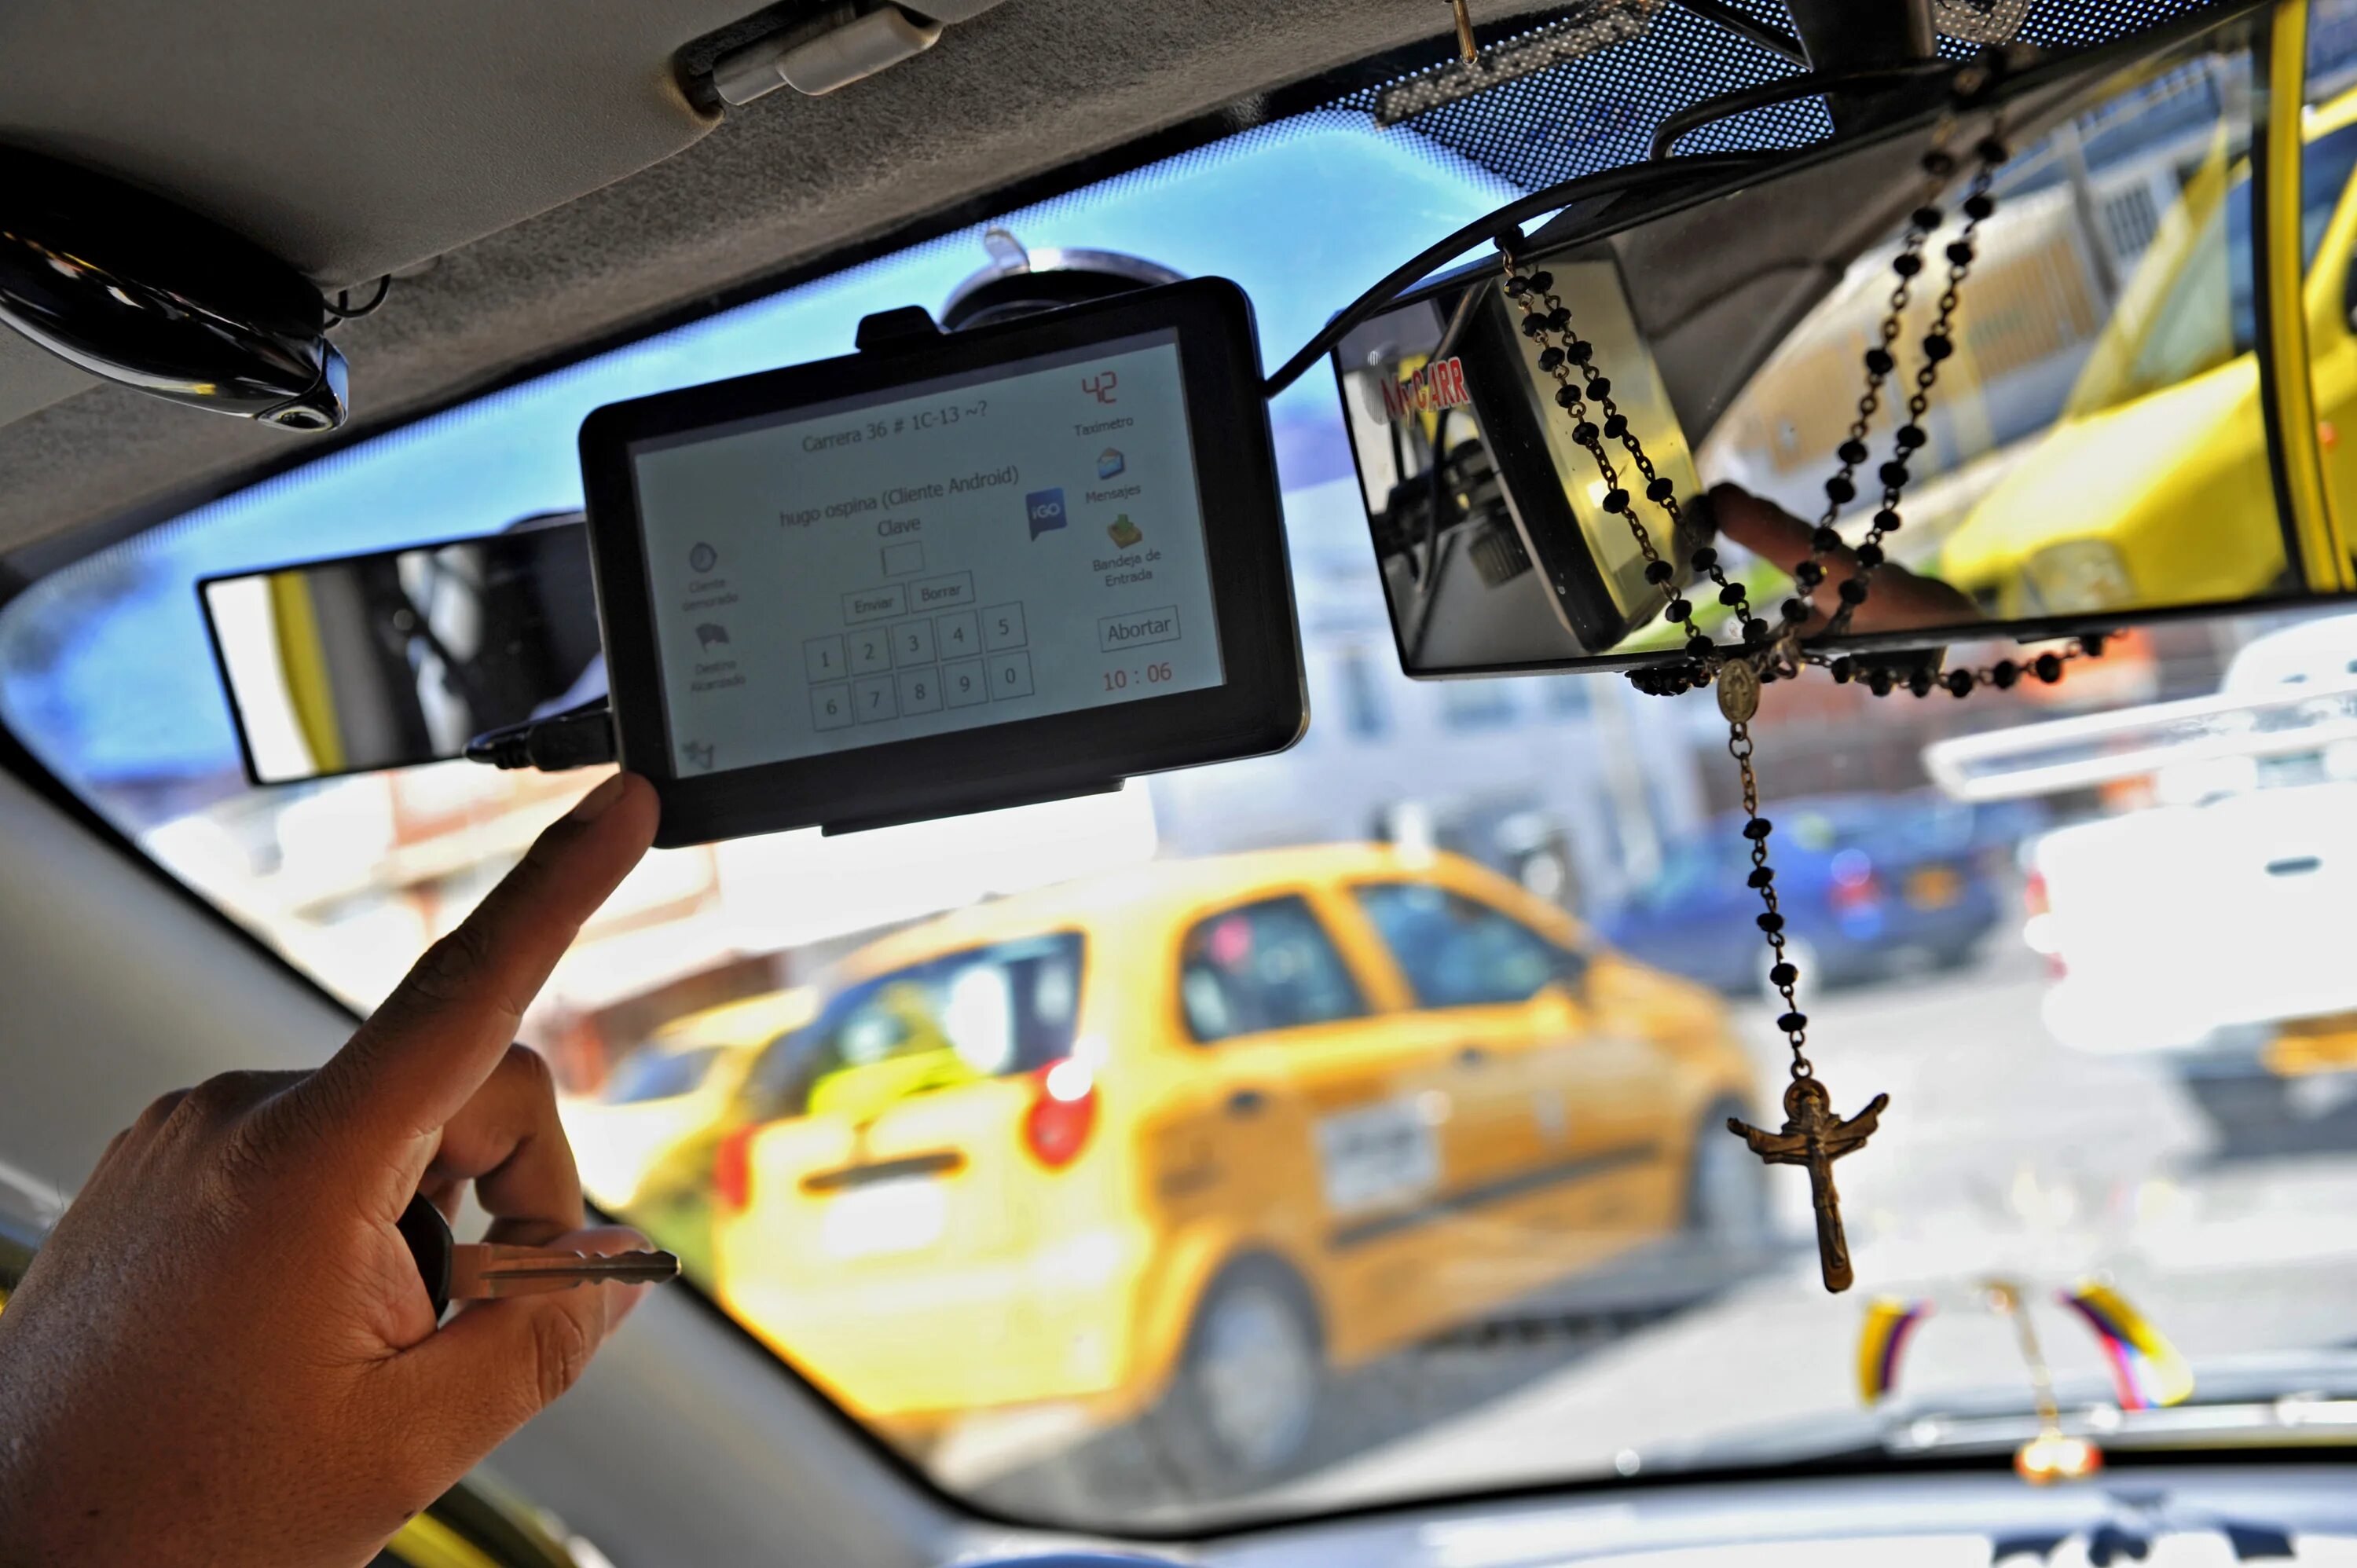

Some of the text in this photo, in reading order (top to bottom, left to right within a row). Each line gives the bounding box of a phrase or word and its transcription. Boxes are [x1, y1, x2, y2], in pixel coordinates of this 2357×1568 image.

[1082, 371, 1116, 404] 42
[802, 429, 862, 453] Carrera
[867, 422, 887, 440] 36
[893, 419, 904, 434] #
[912, 406, 959, 430] 1C-13
[779, 465, 1020, 527] hugo ospina (Cliente Android)
[1086, 485, 1142, 504] Mensajes
[1031, 502, 1061, 520] iGO
[878, 517, 921, 537] Clave
[1093, 548, 1161, 573] Bandeja de
[688, 578, 726, 594] Cliente
[1105, 570, 1153, 588] Entrada
[921, 584, 962, 602] Borrar
[854, 597, 894, 614] Enviar
[1108, 618, 1171, 642] Abortar
[821, 619, 1009, 668] 1 2 3 4 5
[695, 660, 737, 676] Destino
[1104, 670, 1127, 691] 10
[1147, 662, 1171, 683] 06
[827, 668, 1016, 715] 6 7 8 9 0
